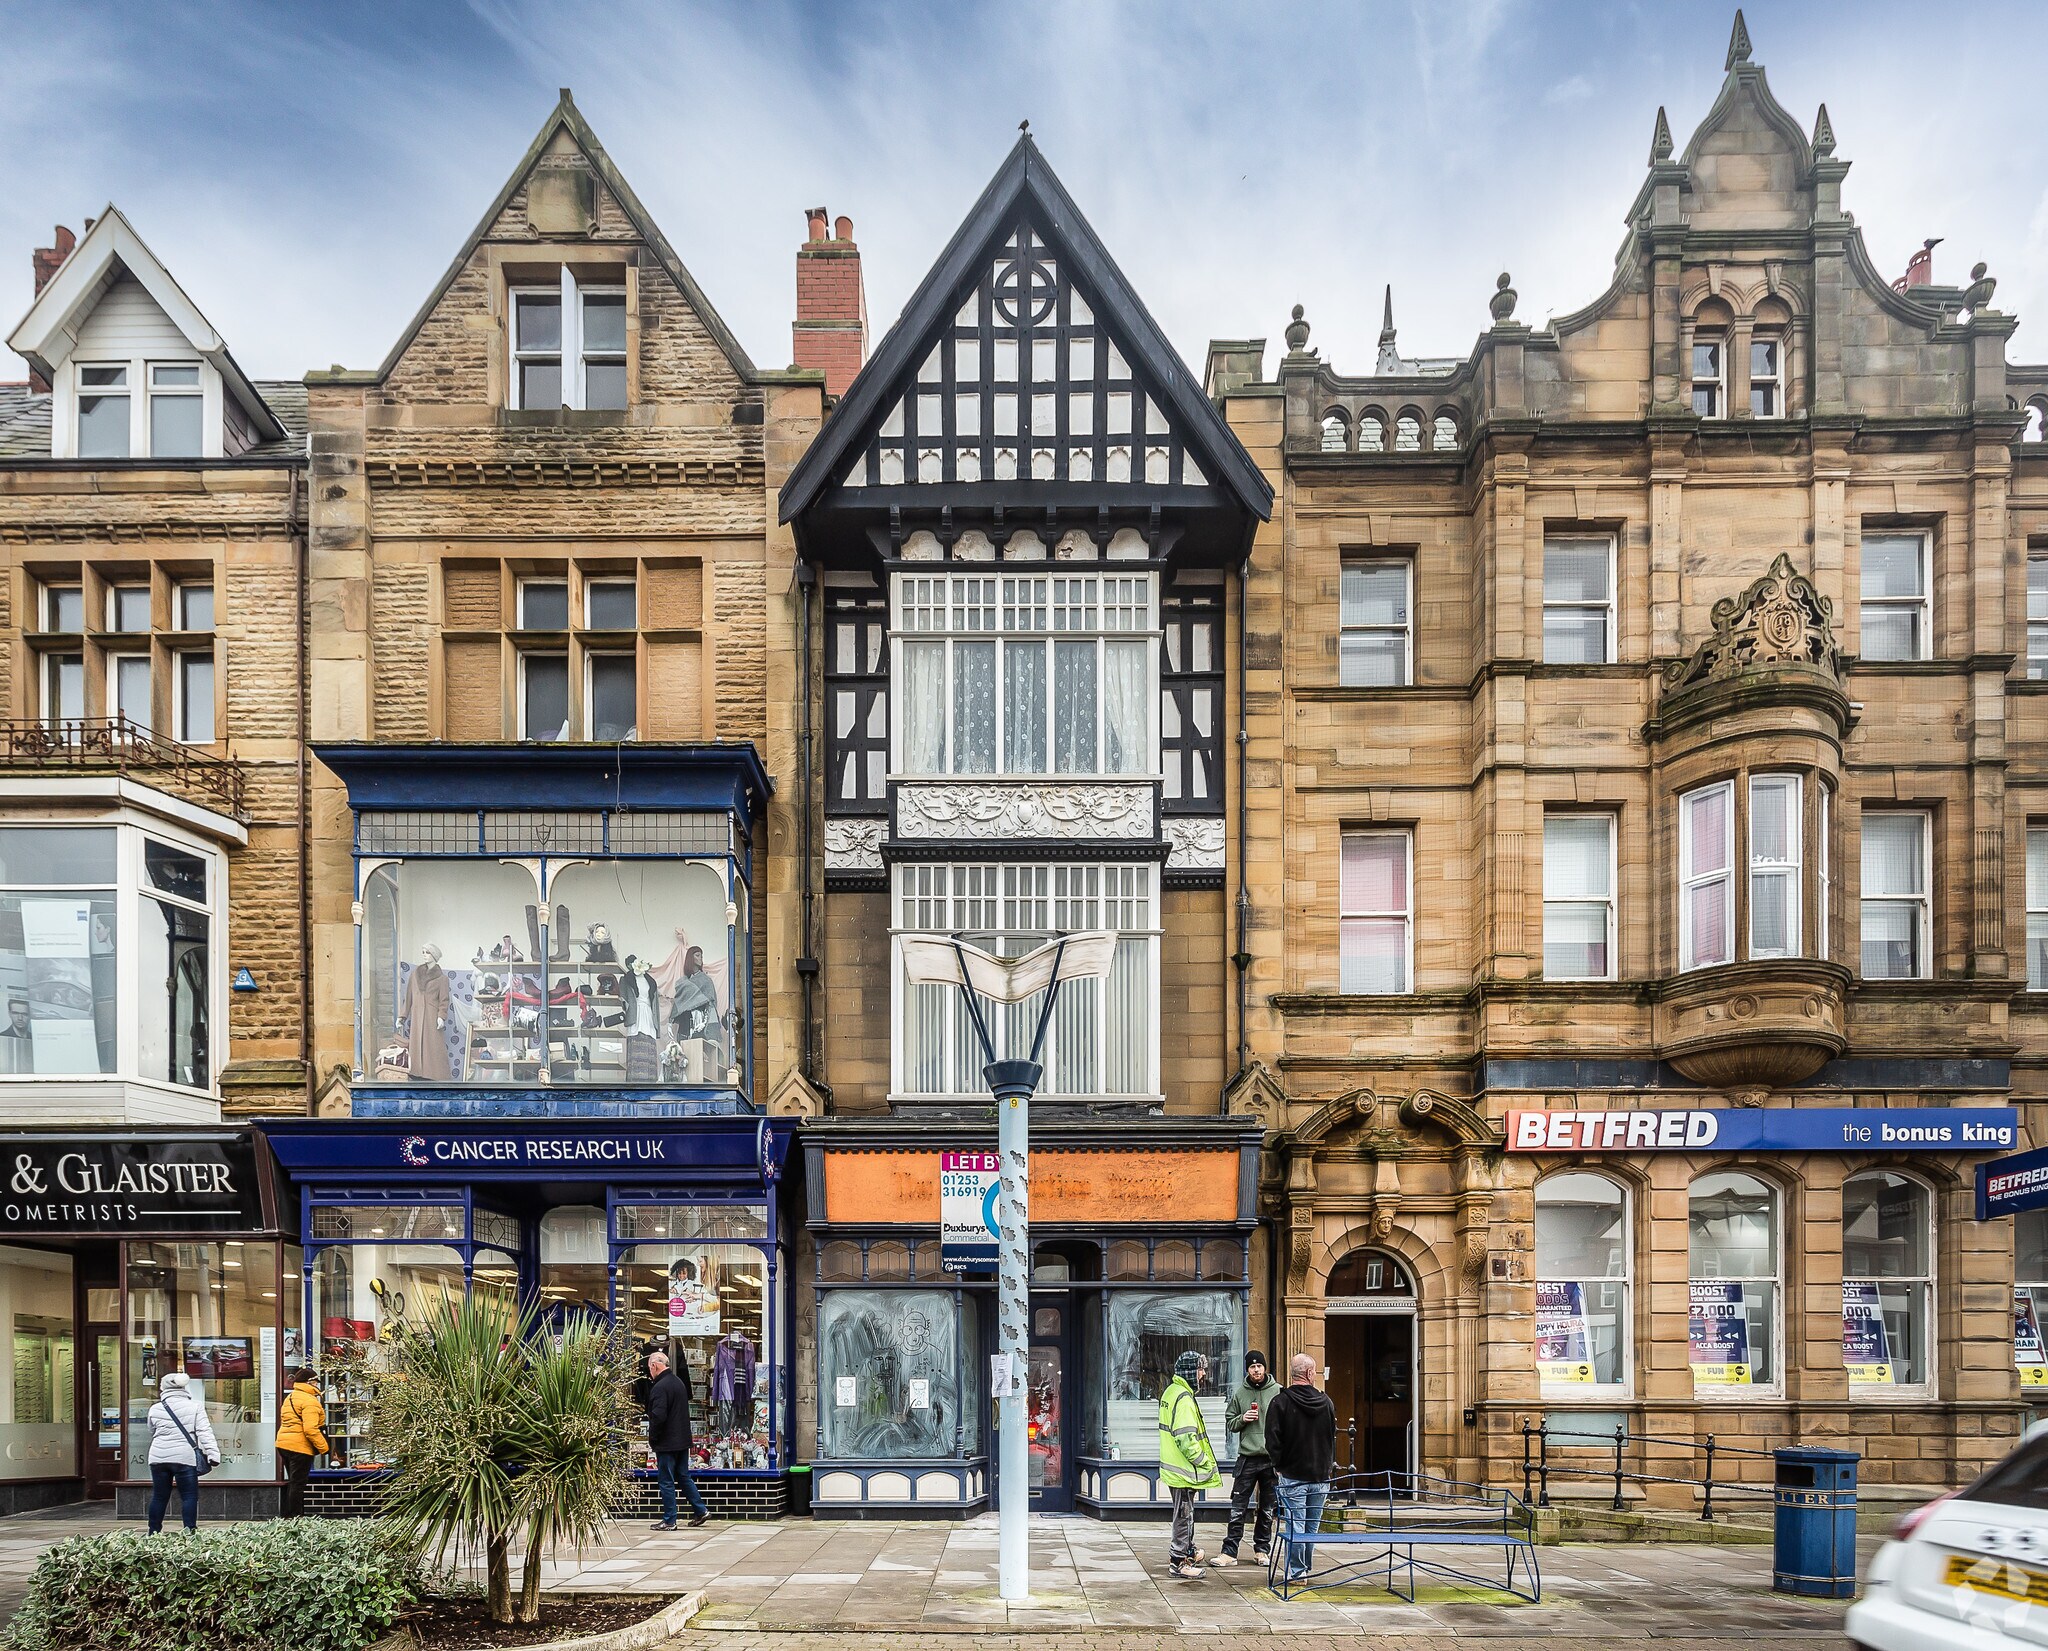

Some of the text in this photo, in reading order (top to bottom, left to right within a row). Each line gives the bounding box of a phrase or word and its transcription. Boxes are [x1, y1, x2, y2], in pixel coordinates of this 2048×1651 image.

[1012, 1099, 1018, 1108] 9
[1516, 1111, 1719, 1148] BETFRED
[1842, 1123, 2012, 1145] the bonus king
[434, 1140, 519, 1160] CANCER
[525, 1140, 631, 1160] RESEARCH
[636, 1140, 665, 1159] UK
[949, 1155, 980, 1170] LET
[11, 1153, 238, 1194] & GLAISTER
[942, 1175, 979, 1186] 01253
[1988, 1166, 2048, 1193] BETFRED
[942, 1187, 986, 1198] 316919
[1989, 1182, 2048, 1202] THE BONUS KING
[943, 1223, 985, 1235] Duxburys
[943, 1232, 989, 1242] Commercial
[1537, 1282, 1566, 1294] BEST
[1690, 1286, 1726, 1297] BOOST
[1536, 1294, 1570, 1305] ODDS
[1551, 1367, 1568, 1375] FUN
[232, 1438, 242, 1449] IS
[130, 1454, 145, 1464] AS
